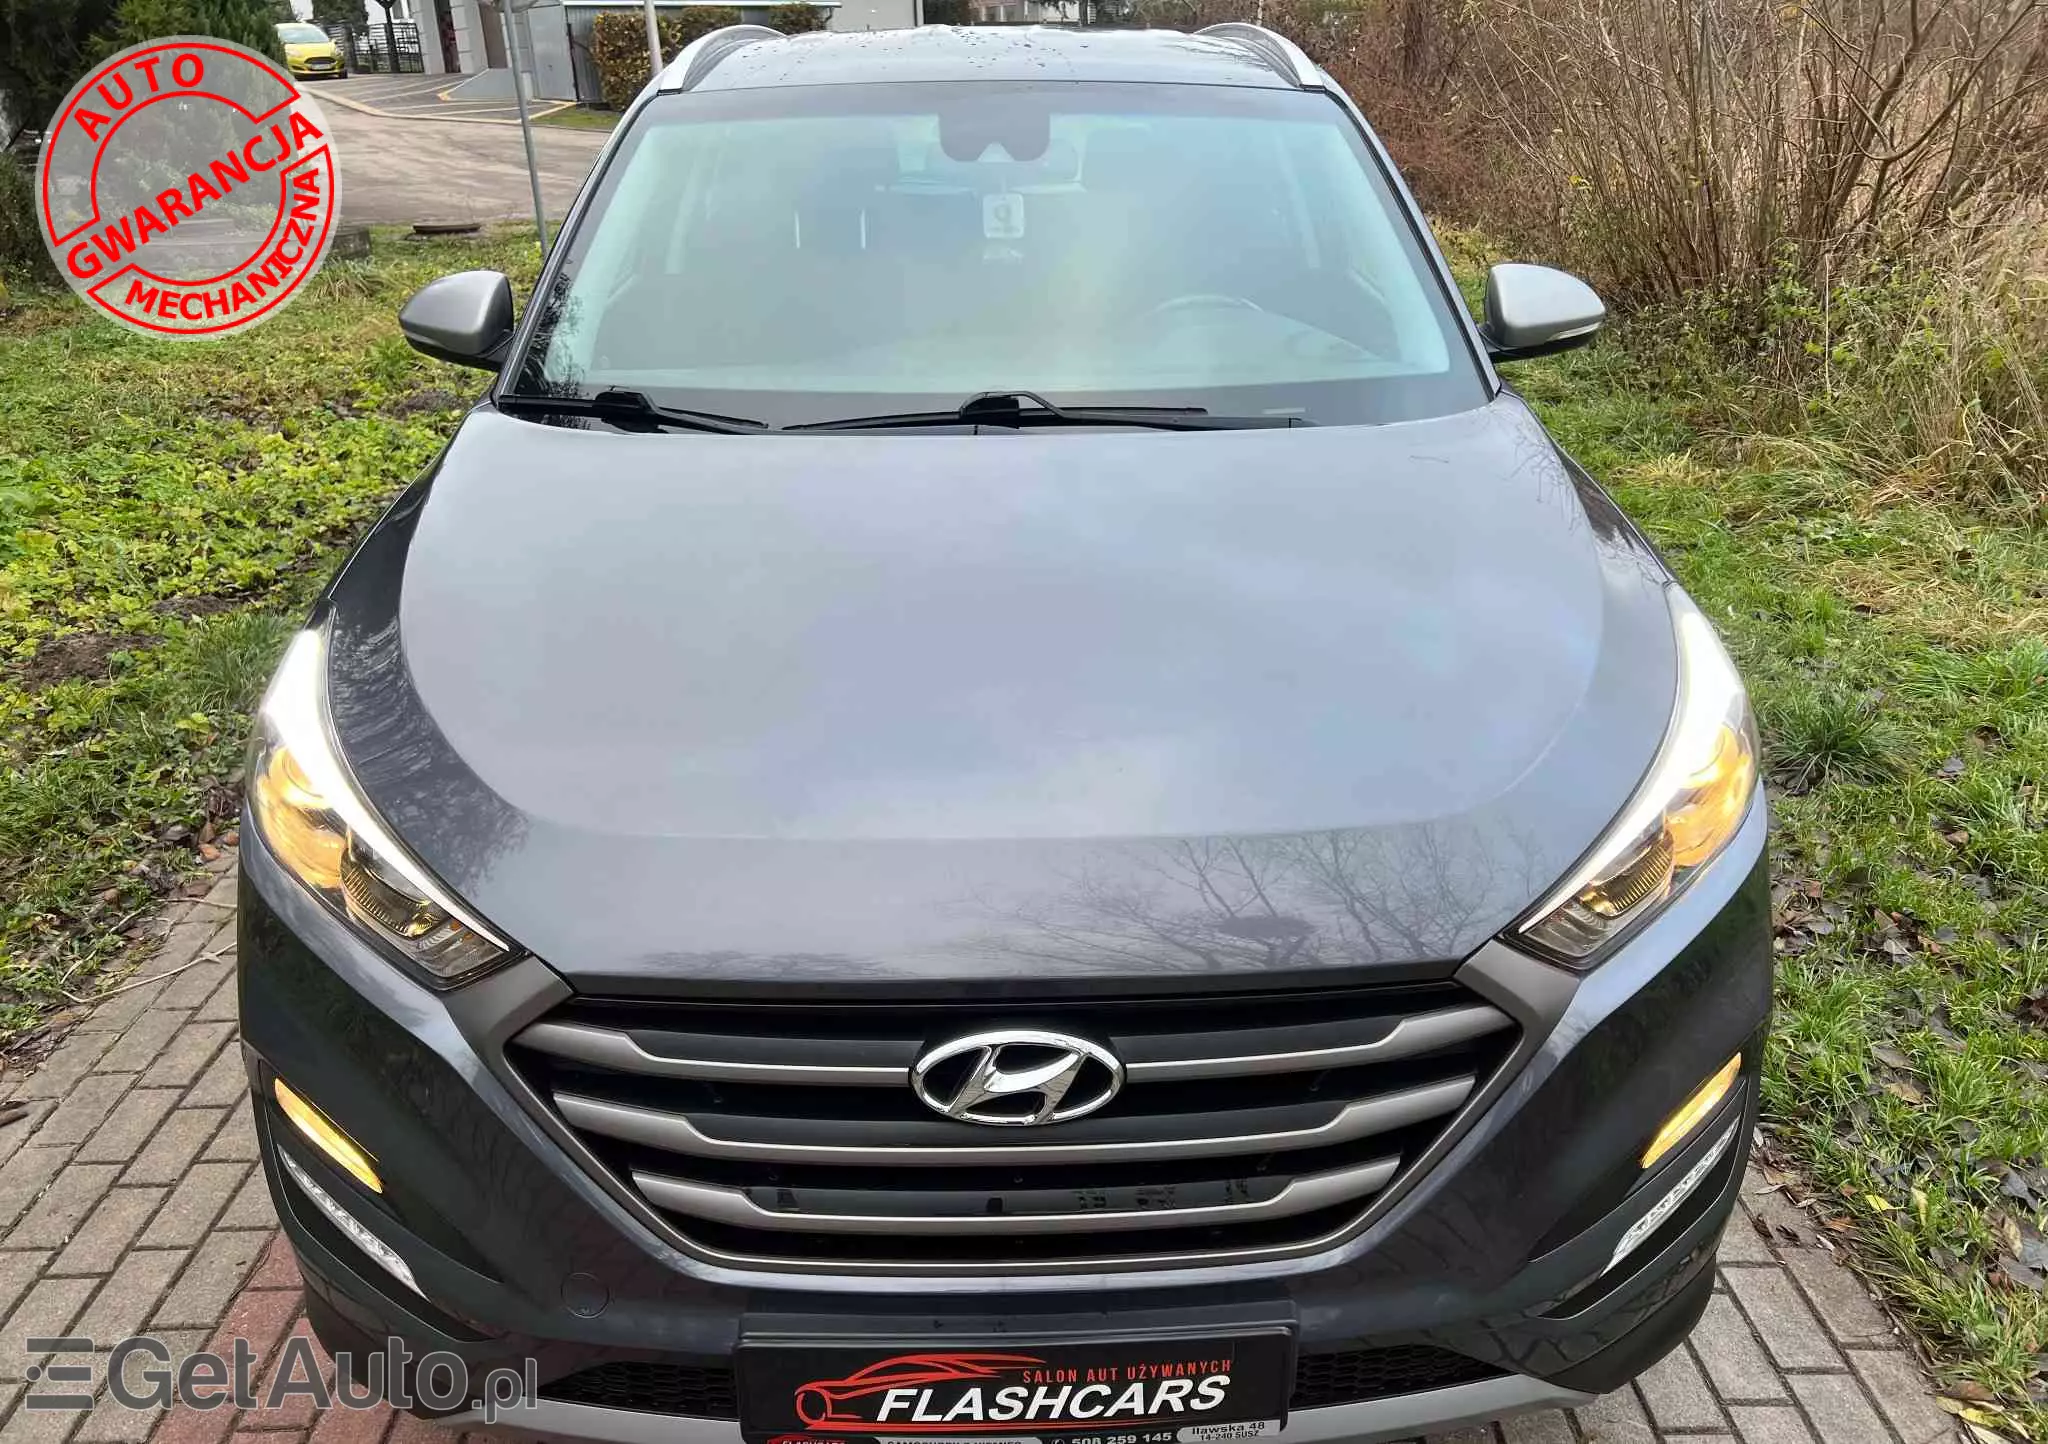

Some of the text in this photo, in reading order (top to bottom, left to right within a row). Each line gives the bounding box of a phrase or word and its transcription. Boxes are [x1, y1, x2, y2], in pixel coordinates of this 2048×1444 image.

[1023, 1359, 1231, 1384] SALON AUT UŻYWANYCH
[876, 1375, 1231, 1422] FLASHCARS
[1248, 1421, 1265, 1430] 48
[1107, 1435, 1137, 1444] 259
[1142, 1432, 1172, 1442] 145
